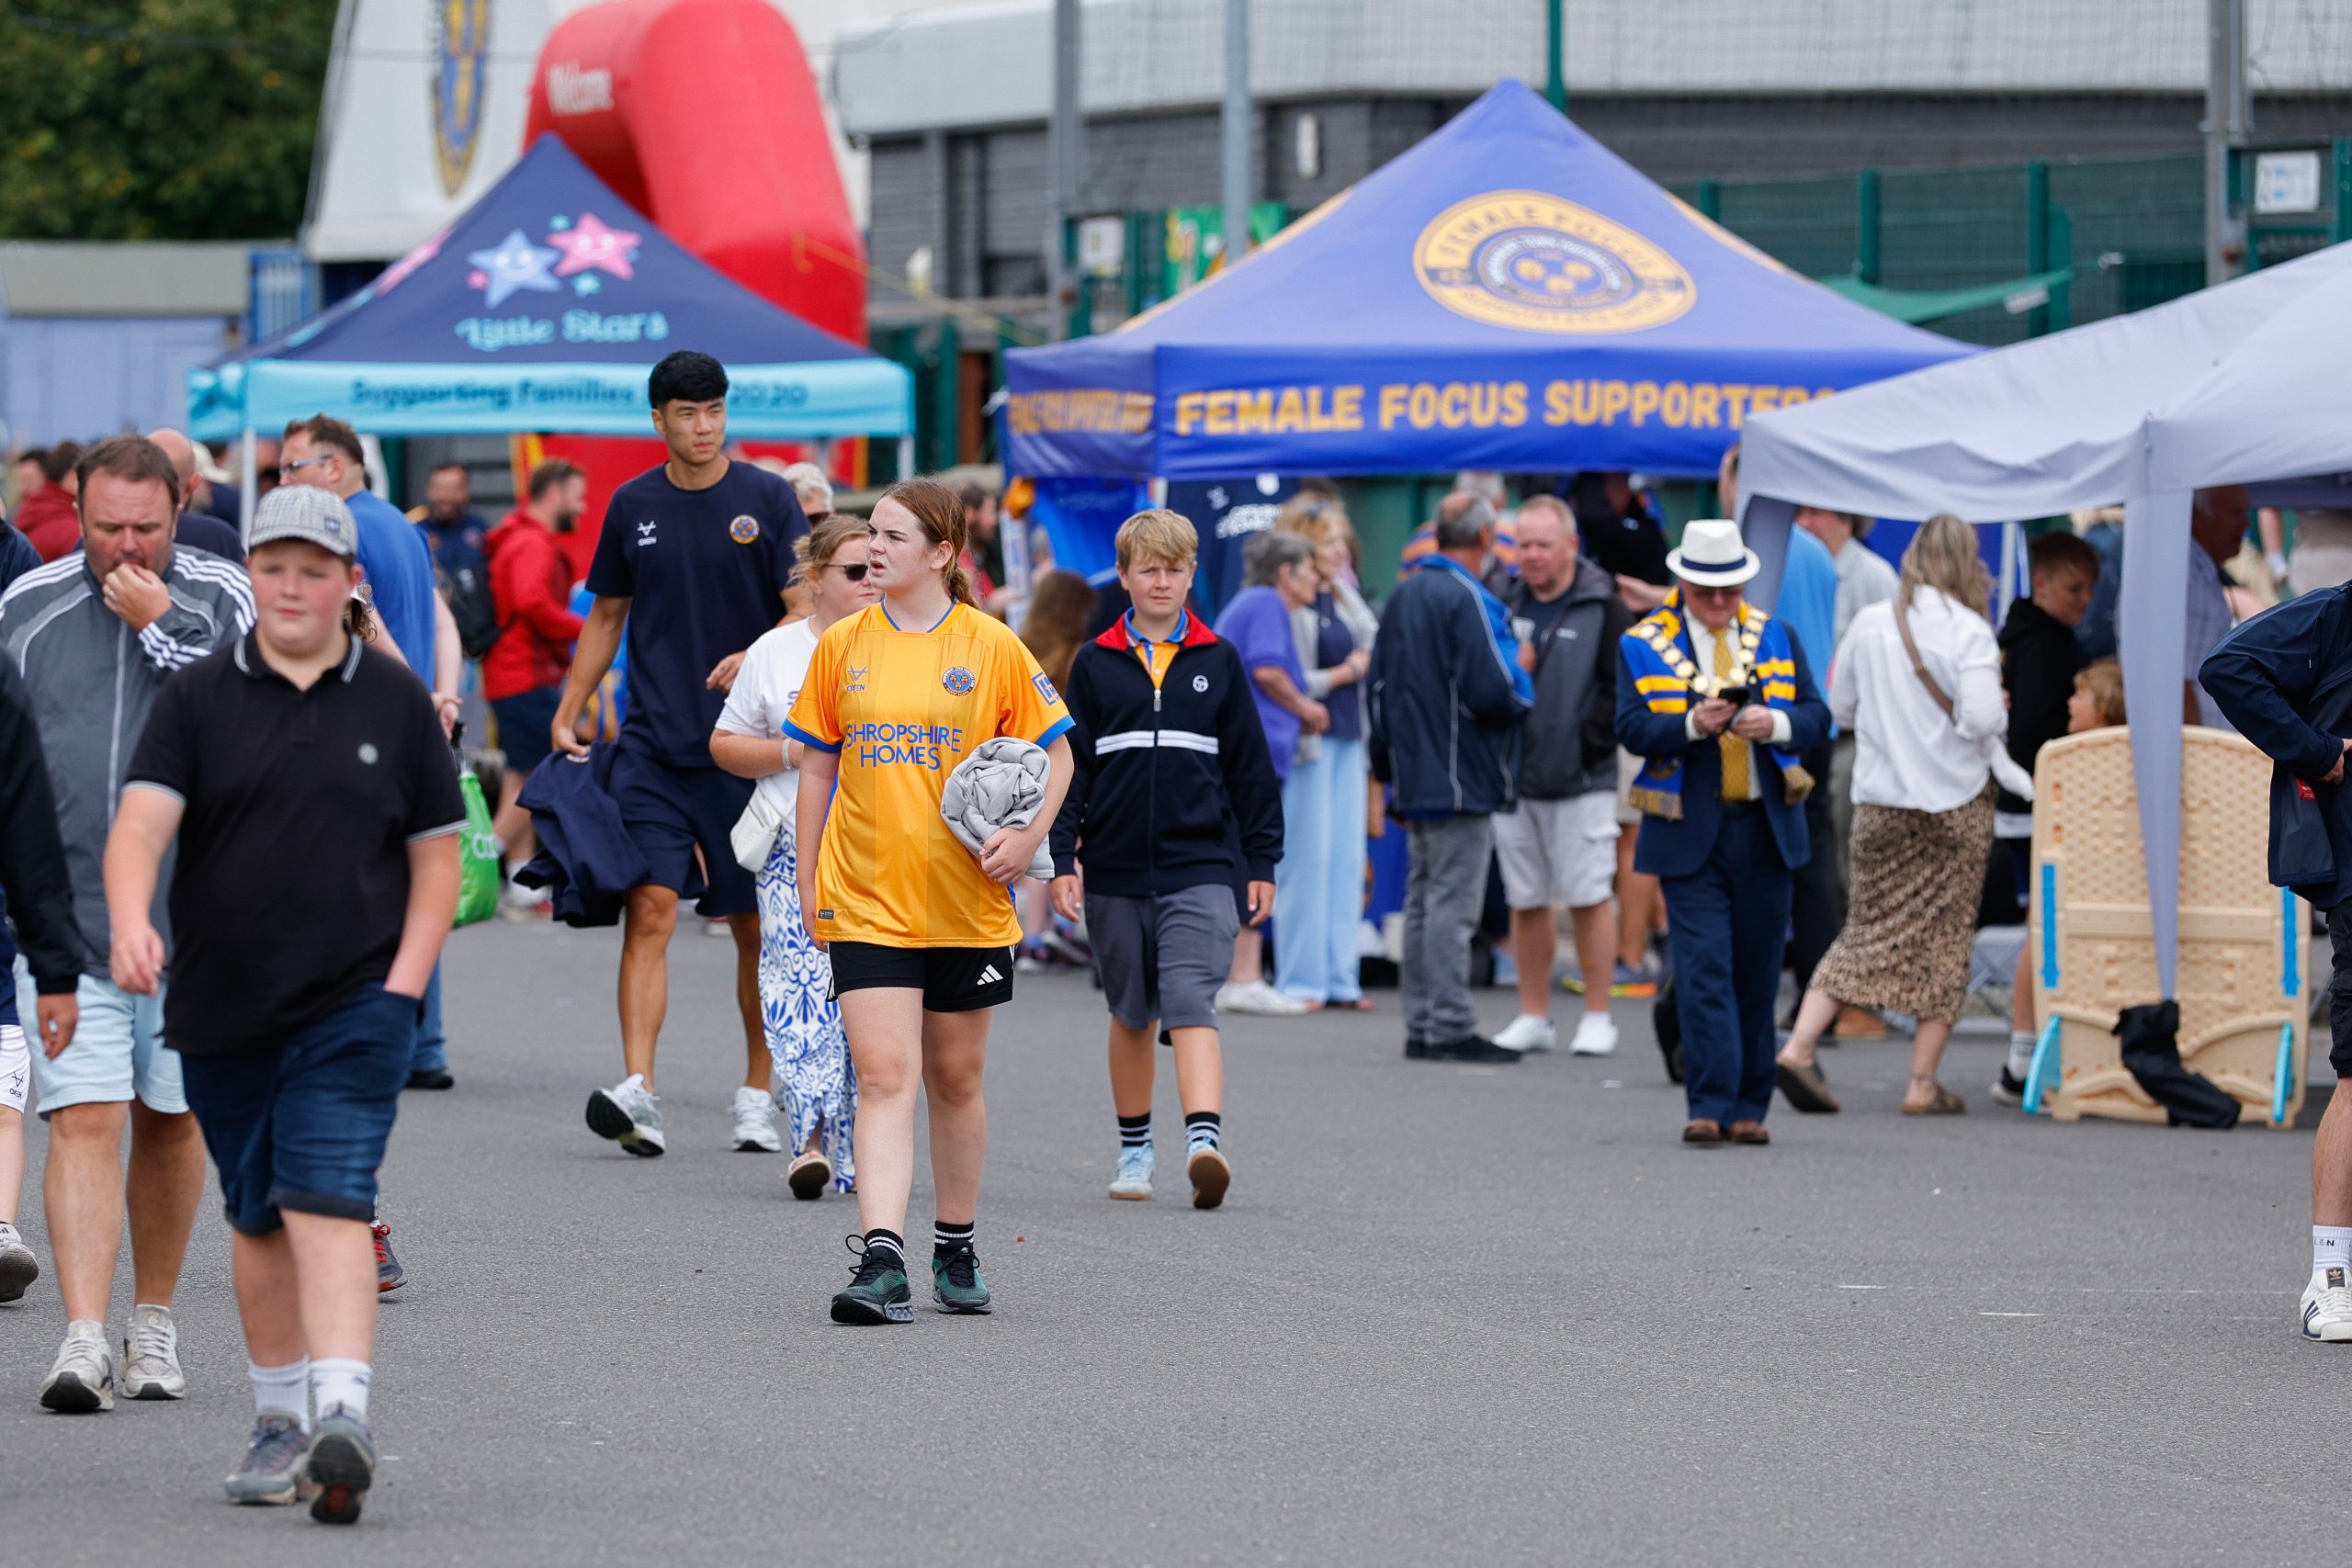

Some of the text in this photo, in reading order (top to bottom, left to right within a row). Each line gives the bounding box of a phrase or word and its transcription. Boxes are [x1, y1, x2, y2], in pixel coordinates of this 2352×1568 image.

[518, 378, 635, 403] Families
[1175, 385, 1364, 435] FEMALE
[1381, 381, 1530, 429] FOCUS
[1543, 378, 1836, 429] SUPPORTE
[845, 722, 963, 753] SHROPSHIRE
[860, 744, 941, 770] HOMES
